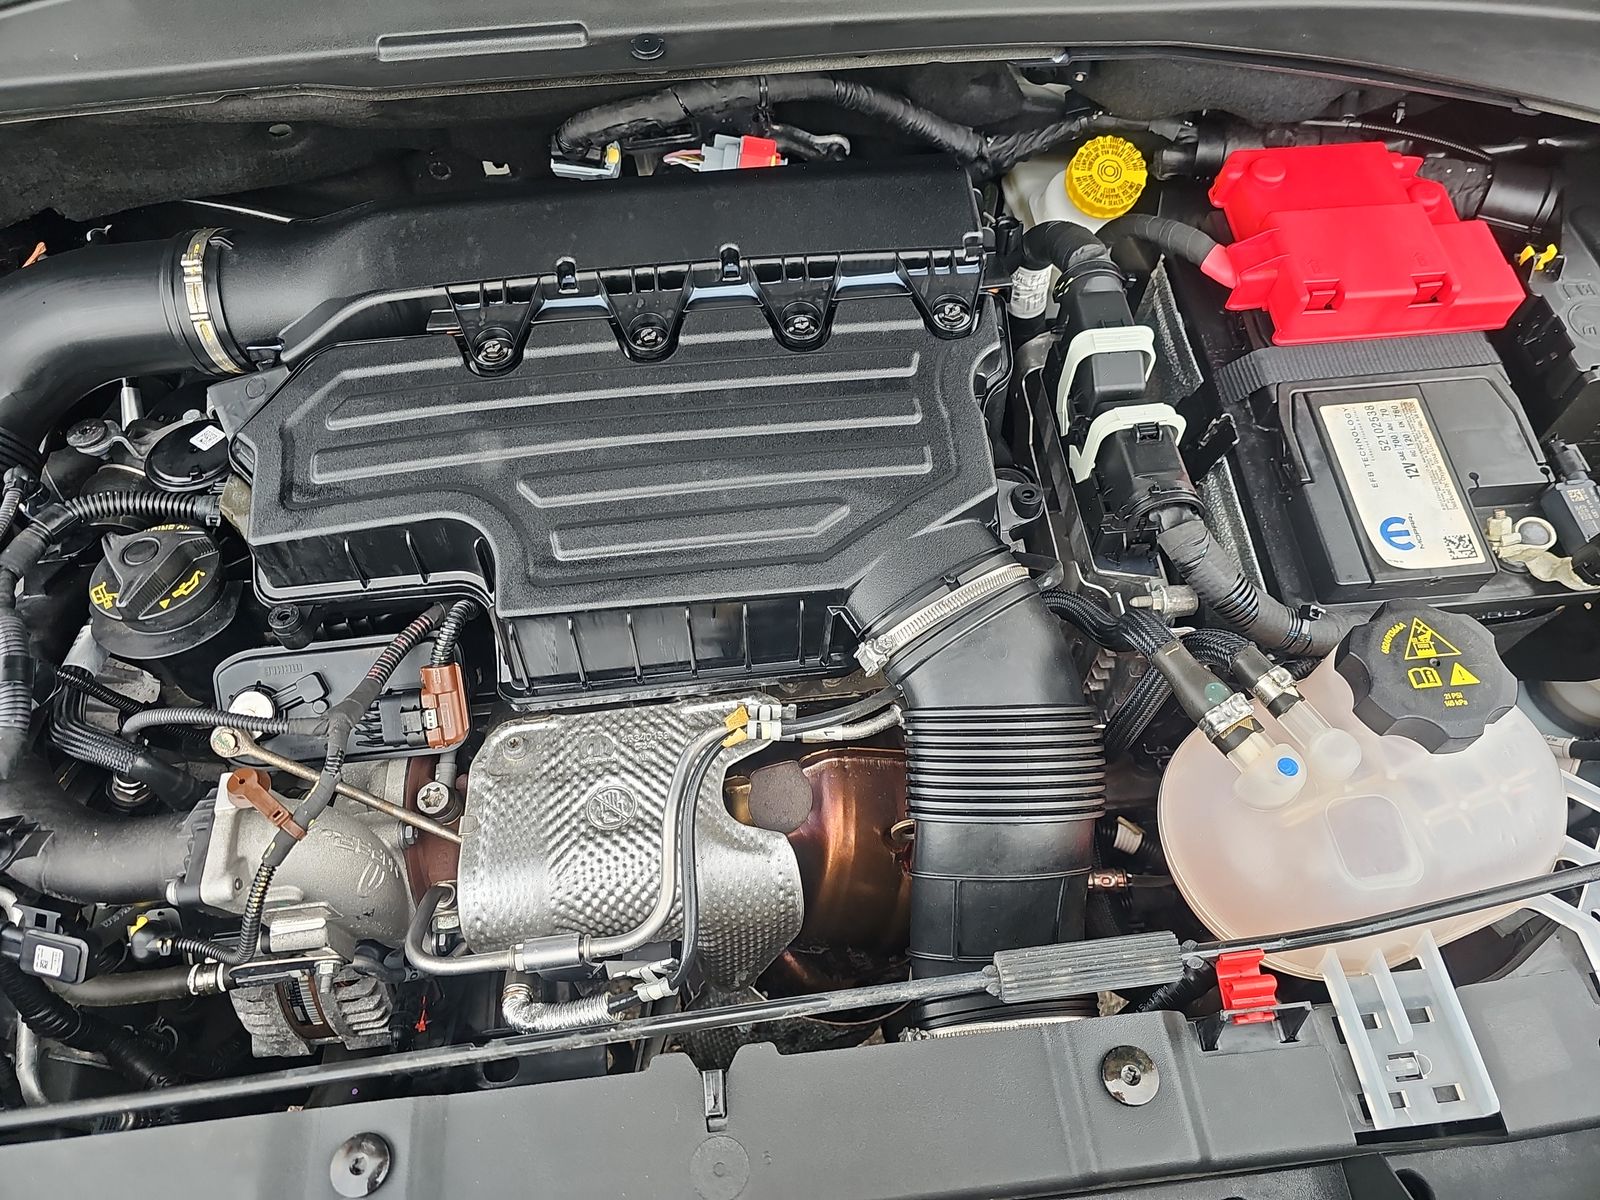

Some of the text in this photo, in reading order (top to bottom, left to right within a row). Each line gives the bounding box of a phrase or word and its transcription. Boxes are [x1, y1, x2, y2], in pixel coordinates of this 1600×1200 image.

[1379, 408, 1389, 417] 70
[1365, 405, 1391, 452] 52102538
[1342, 407, 1378, 488] EFB TECHNOLOGY
[1390, 434, 1402, 448] 700
[1402, 433, 1414, 446] 120
[1401, 461, 1420, 479] 12V
[1408, 516, 1424, 548] MOPAR
